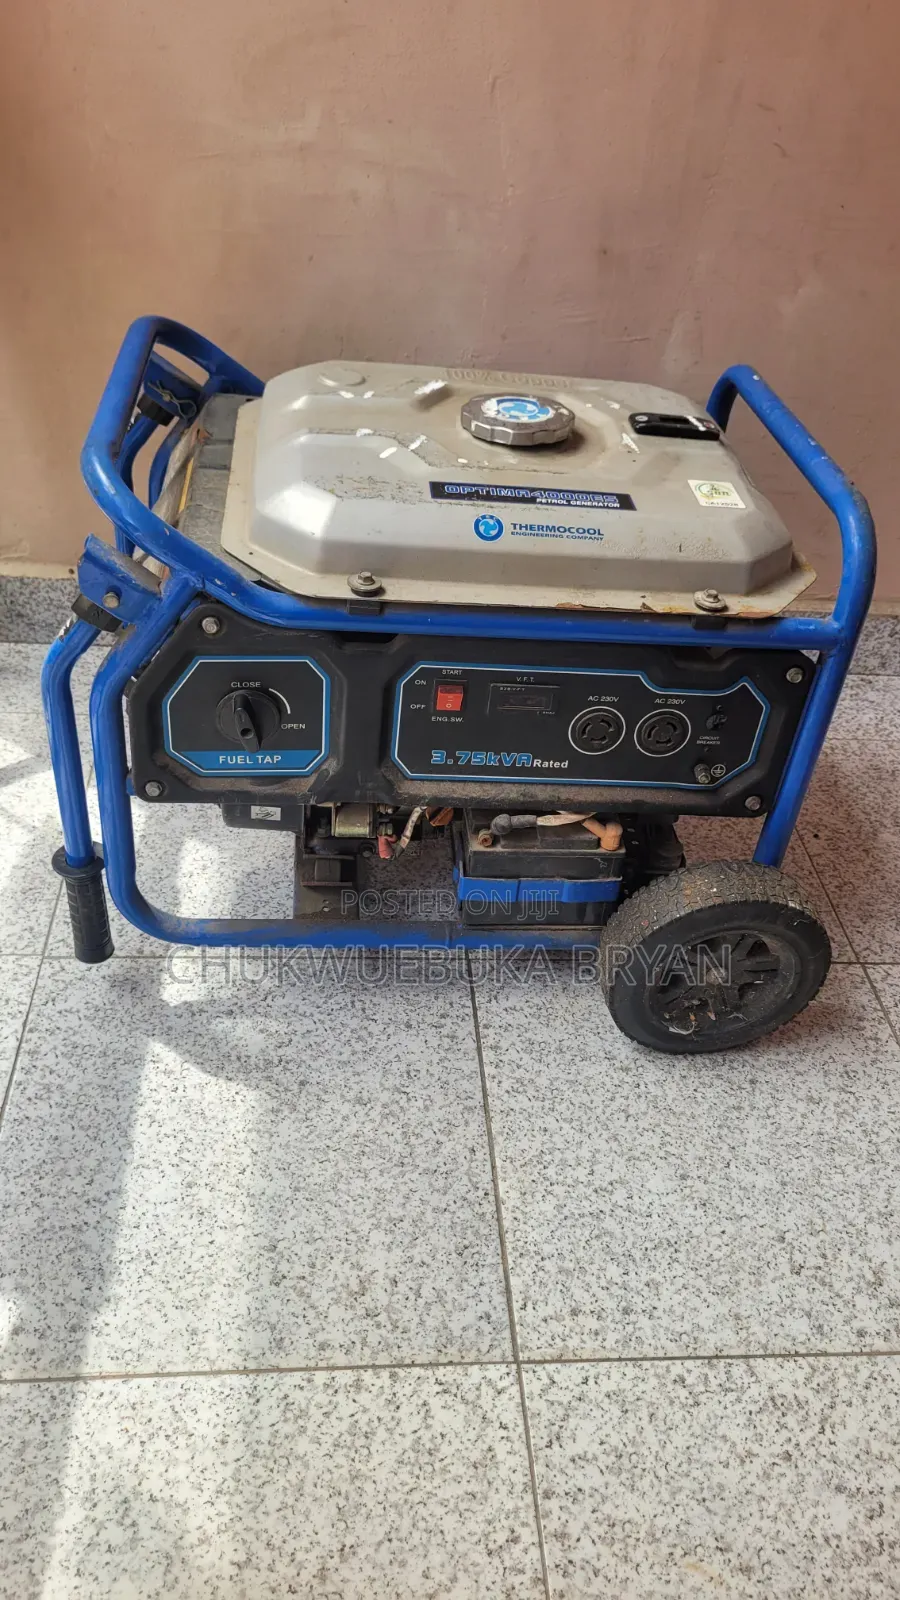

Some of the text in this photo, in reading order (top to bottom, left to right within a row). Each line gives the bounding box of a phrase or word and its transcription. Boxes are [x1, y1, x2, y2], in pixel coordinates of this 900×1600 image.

[444, 484, 619, 503] OPTIMA4000ES
[571, 500, 620, 508] GENERATOR
[511, 522, 604, 536] THERMOCOOL
[511, 531, 563, 539] ENGINEERING
[219, 755, 282, 764] FUEL TAP
[431, 750, 569, 769] 3.75kVA Rated
